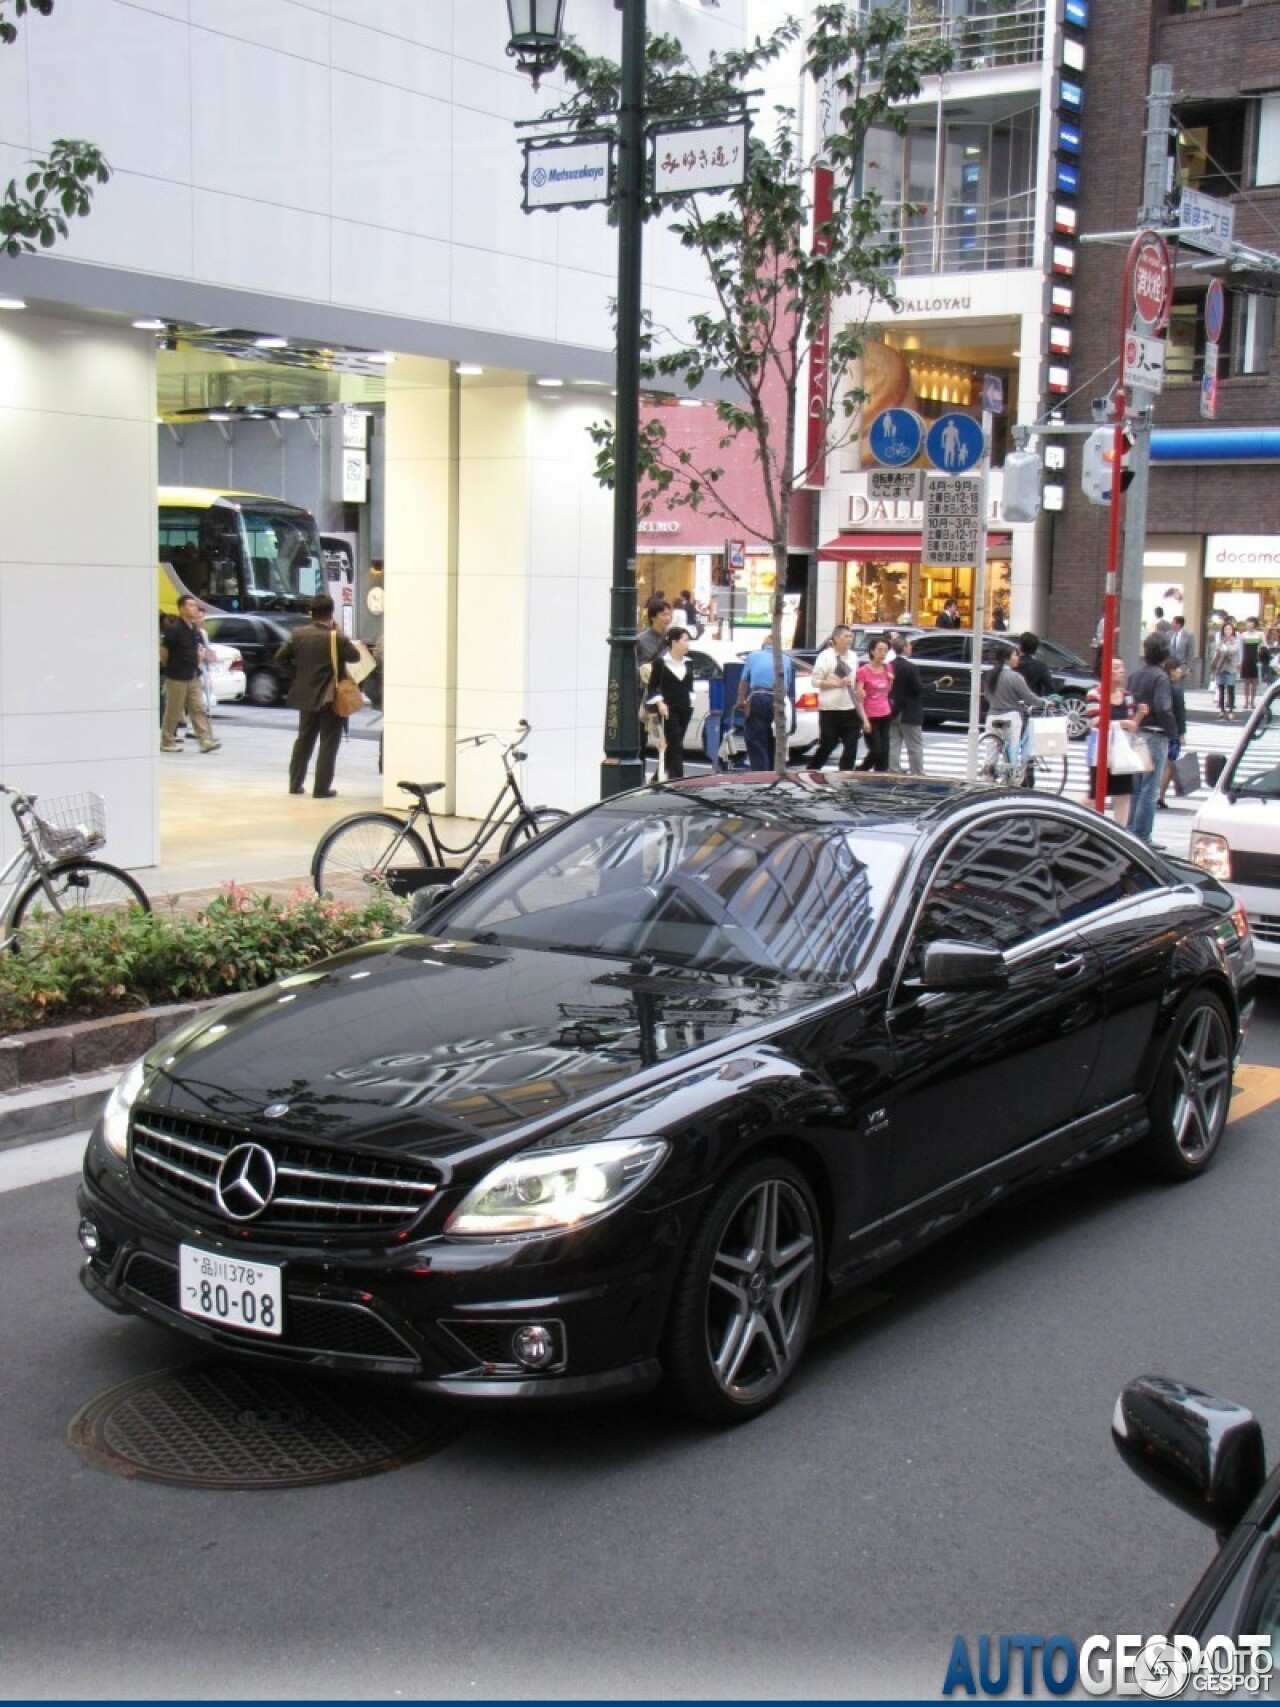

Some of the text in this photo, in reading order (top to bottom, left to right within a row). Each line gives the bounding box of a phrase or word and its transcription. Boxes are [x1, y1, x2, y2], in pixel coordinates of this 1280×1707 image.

[661, 146, 739, 173] みゆき通り
[549, 165, 604, 182] Matsuzakaya
[201, 1257, 255, 1285] 品川378
[200, 1279, 275, 1327] 80-08
